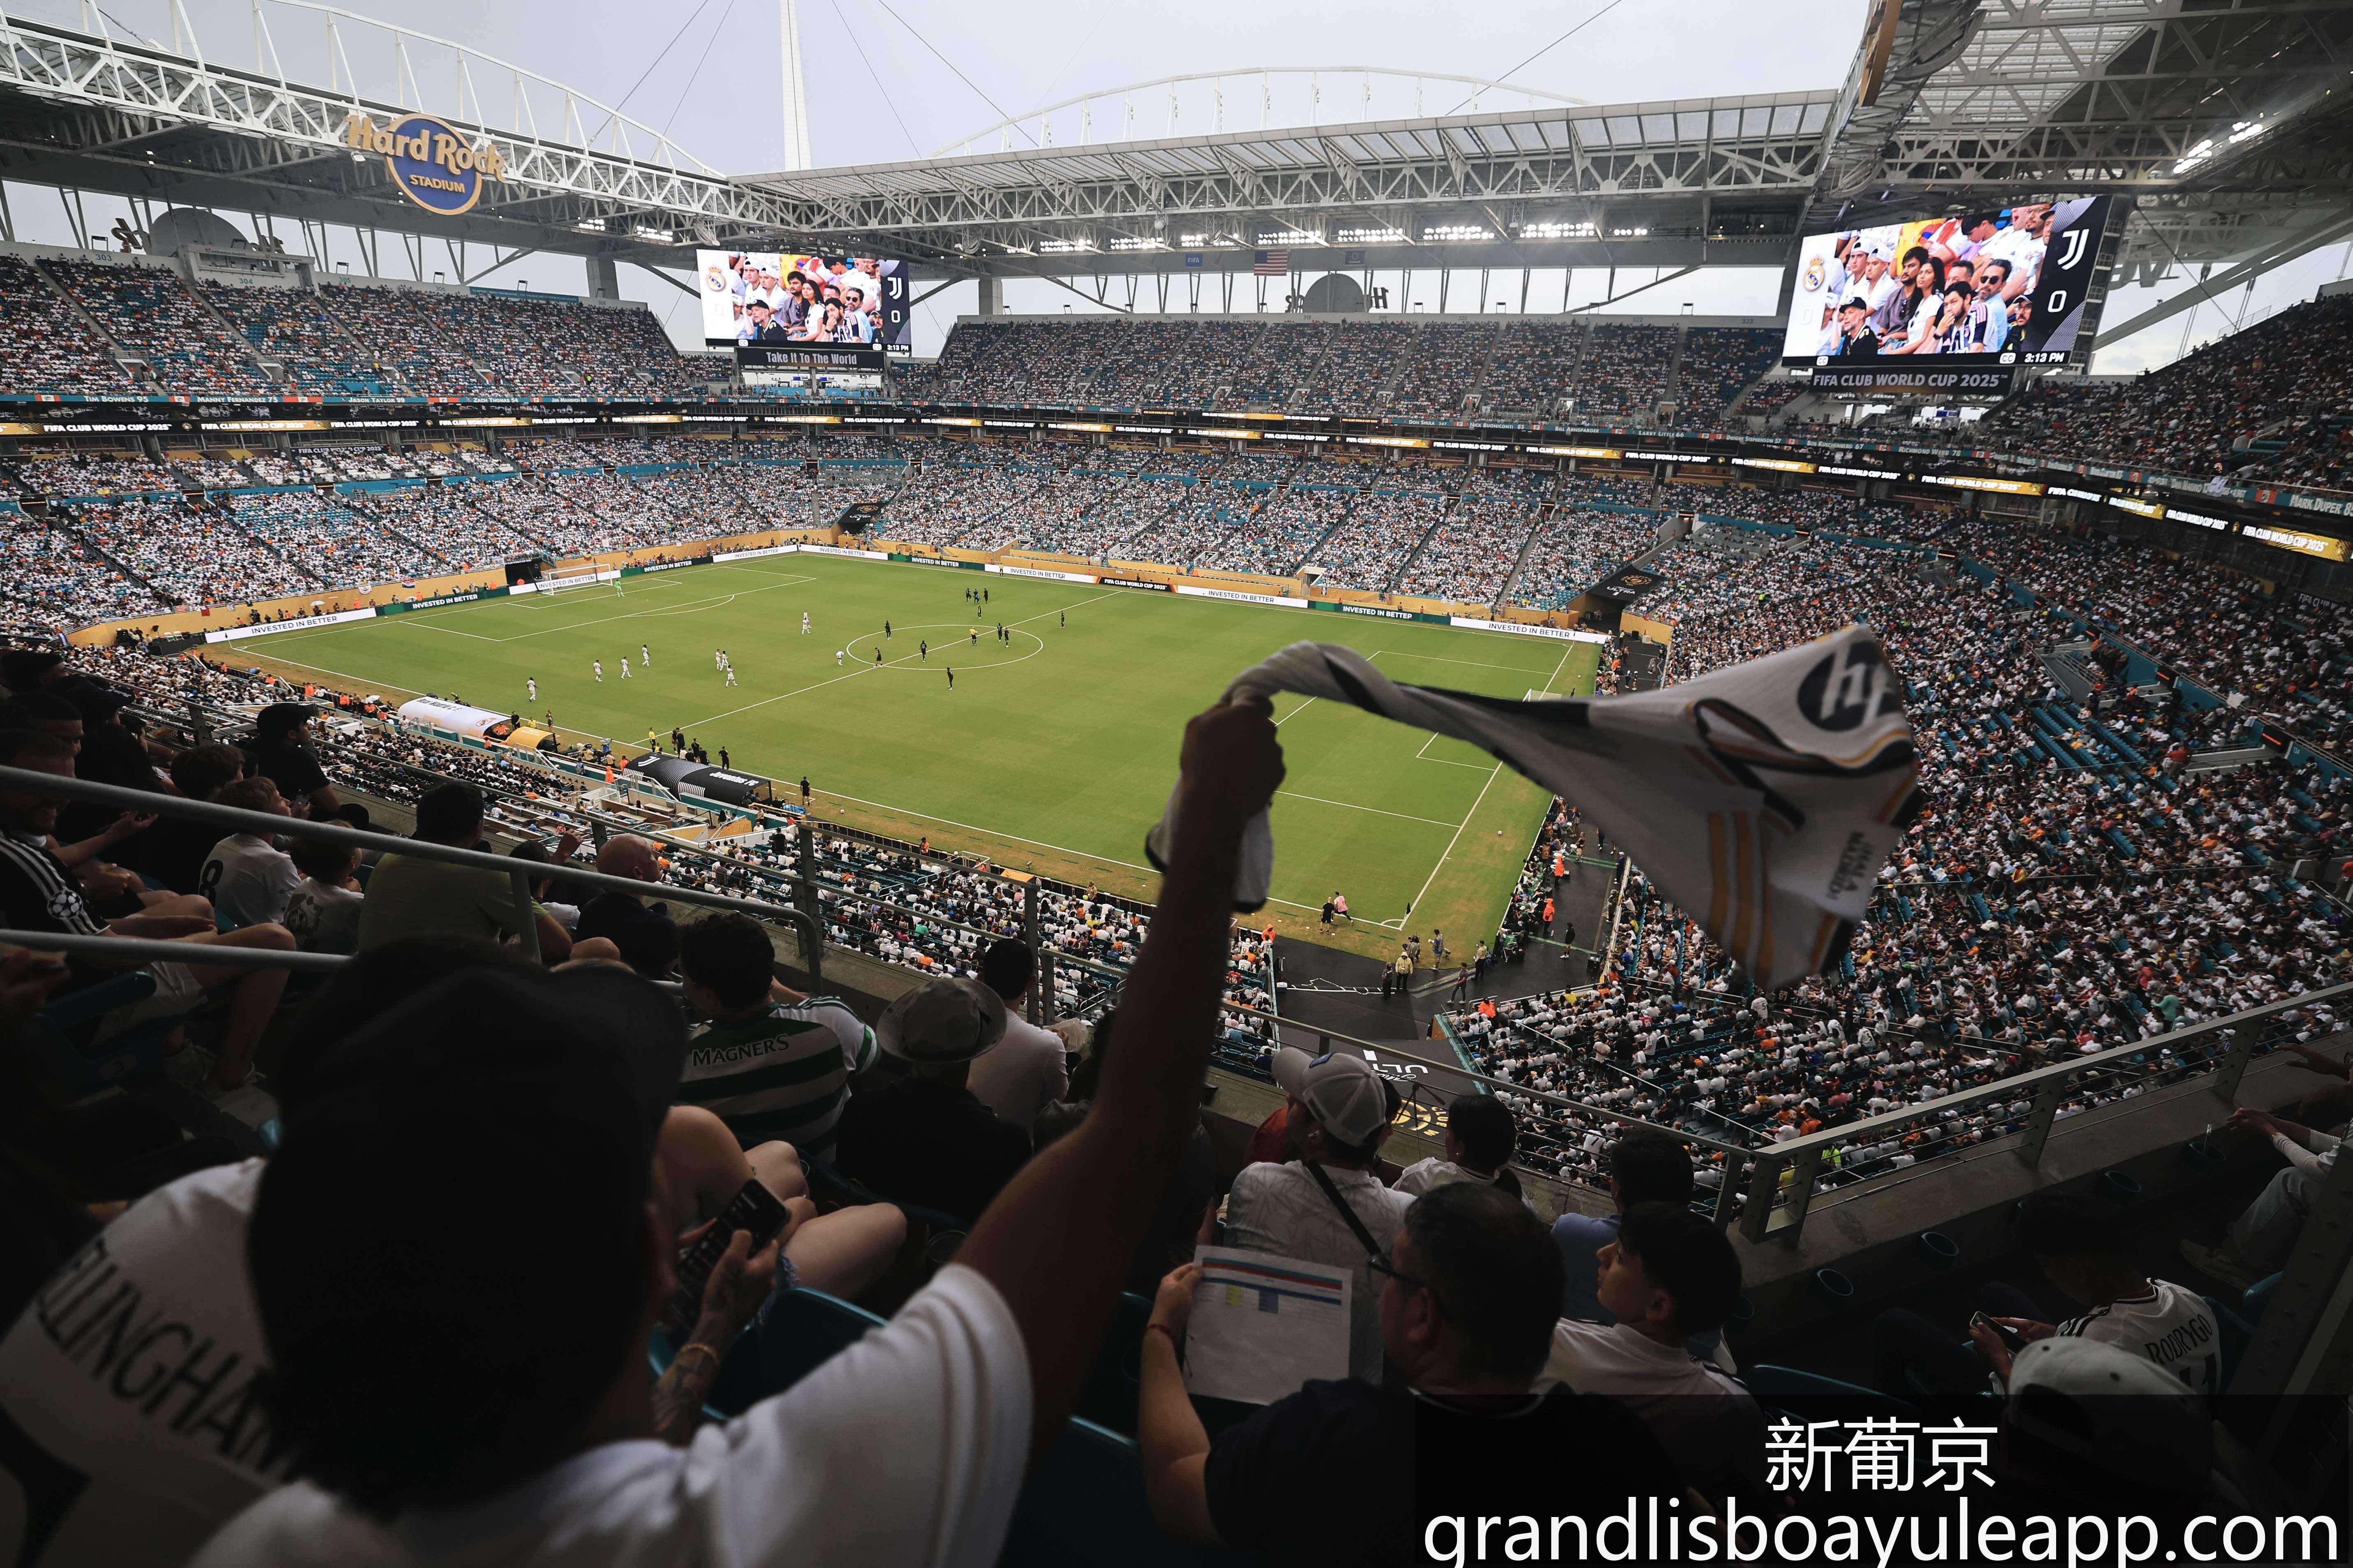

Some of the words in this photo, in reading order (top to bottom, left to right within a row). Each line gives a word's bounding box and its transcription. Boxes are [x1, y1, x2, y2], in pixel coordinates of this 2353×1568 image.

[345, 116, 430, 161] Hard
[433, 133, 506, 183] Rock
[409, 174, 466, 193] STADIUM
[2047, 290, 2066, 312] 0
[892, 310, 901, 323] 0
[767, 352, 788, 363] Take
[790, 353, 797, 362] It
[799, 353, 810, 363] To
[812, 353, 829, 363] The
[831, 354, 857, 364] World
[2024, 353, 2047, 363] 3:13
[2049, 352, 2065, 362] PM
[1813, 375, 1838, 386] FIFA
[1840, 375, 1873, 386] CLUB
[1876, 374, 1925, 386] WORLD
[1927, 375, 1958, 386] CUP
[1847, 468, 1868, 476] WORLD
[412, 600, 445, 609] INVESTED
[455, 594, 478, 603] BETTER
[1343, 606, 1376, 615] INVESTED
[251, 623, 294, 634] INVESTED
[307, 616, 338, 626] BETTER
[1489, 623, 1527, 632] INVESTED
[1540, 629, 1570, 638] BETTER
[709, 772, 748, 784] Juventus
[199, 859, 224, 907] 8
[1591, 1137, 1599, 1146] 7
[2145, 1314, 2212, 1365] RODRYGO
